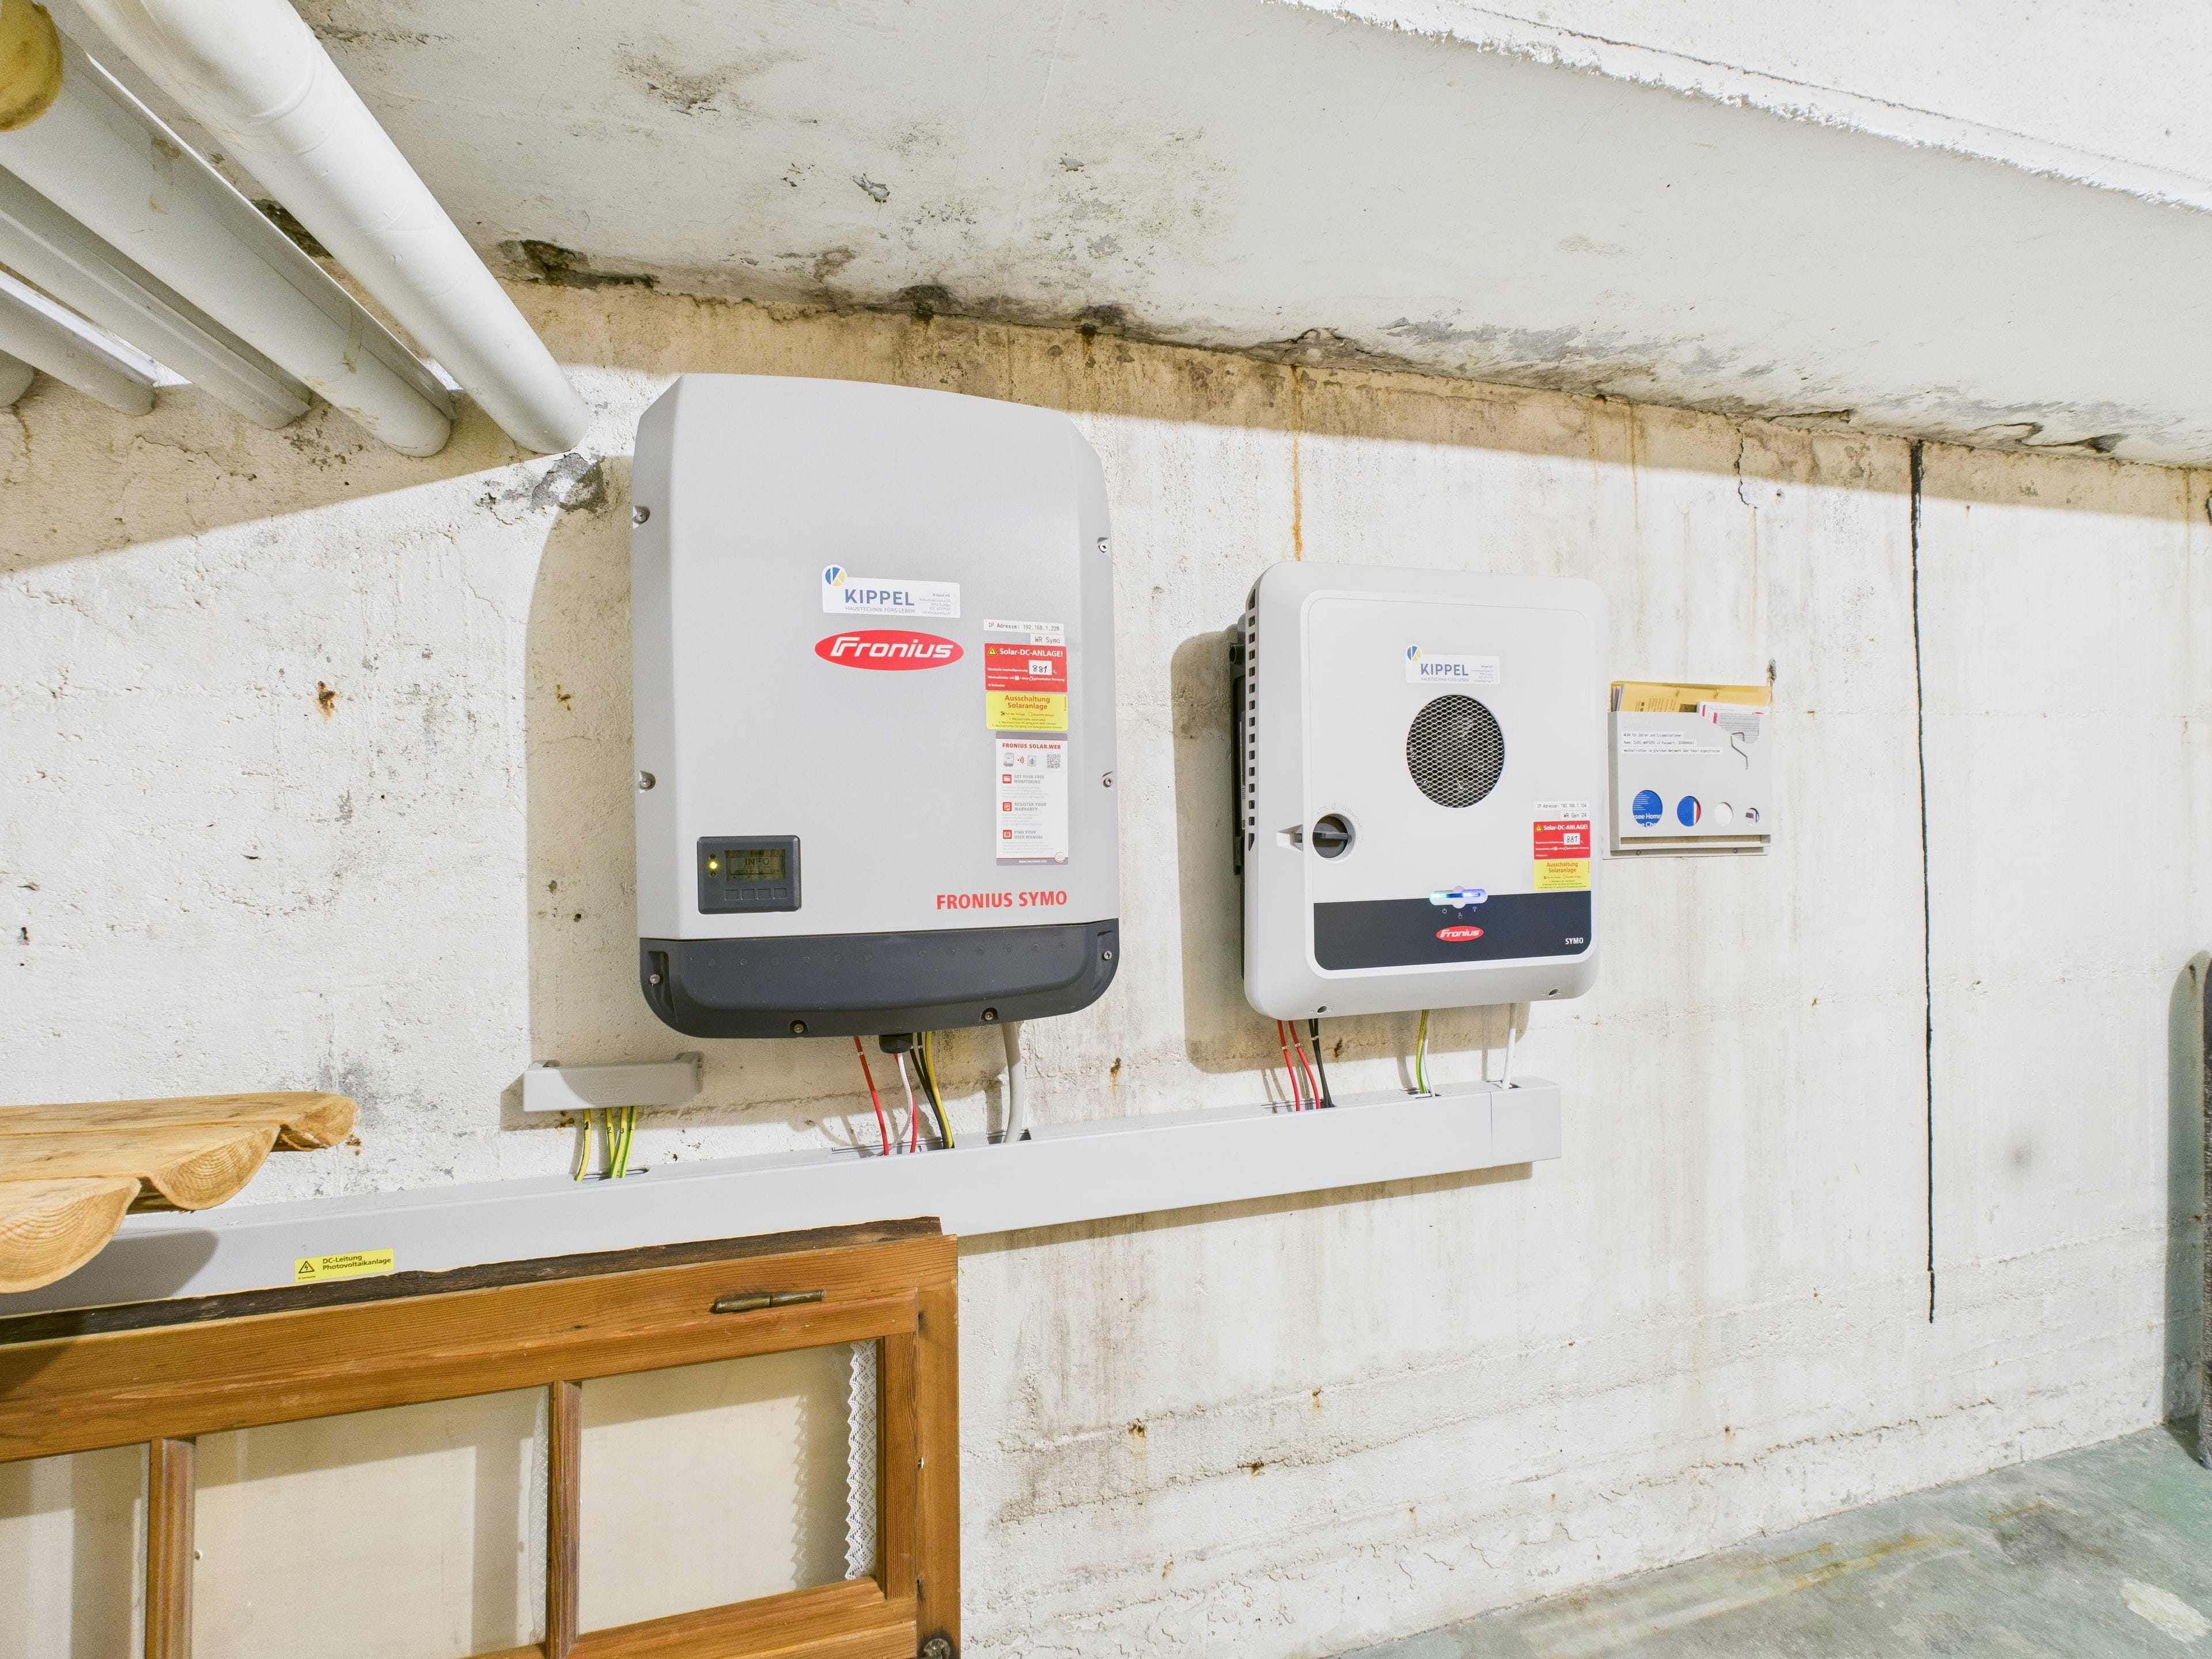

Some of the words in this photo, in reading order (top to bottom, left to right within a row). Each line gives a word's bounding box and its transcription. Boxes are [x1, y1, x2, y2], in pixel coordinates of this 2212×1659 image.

[844, 589, 915, 606] KIPPEL
[830, 637, 954, 658] Fronius
[999, 648, 1063, 657] Solar-DC-ANLAGE!
[1032, 665, 1047, 673] 881
[1421, 663, 1468, 676] KIPPEL
[1005, 695, 1050, 703] Ausschaltung
[1007, 702, 1048, 710] Solaranlage
[936, 892, 1013, 910] FRONIUS
[1018, 891, 1067, 907] SYMO
[1440, 929, 1480, 938] Fronius
[1565, 937, 1584, 945] SYMO
[323, 1255, 362, 1264] DC-Leitung
[323, 1258, 391, 1271] Photovoltaikanlage
